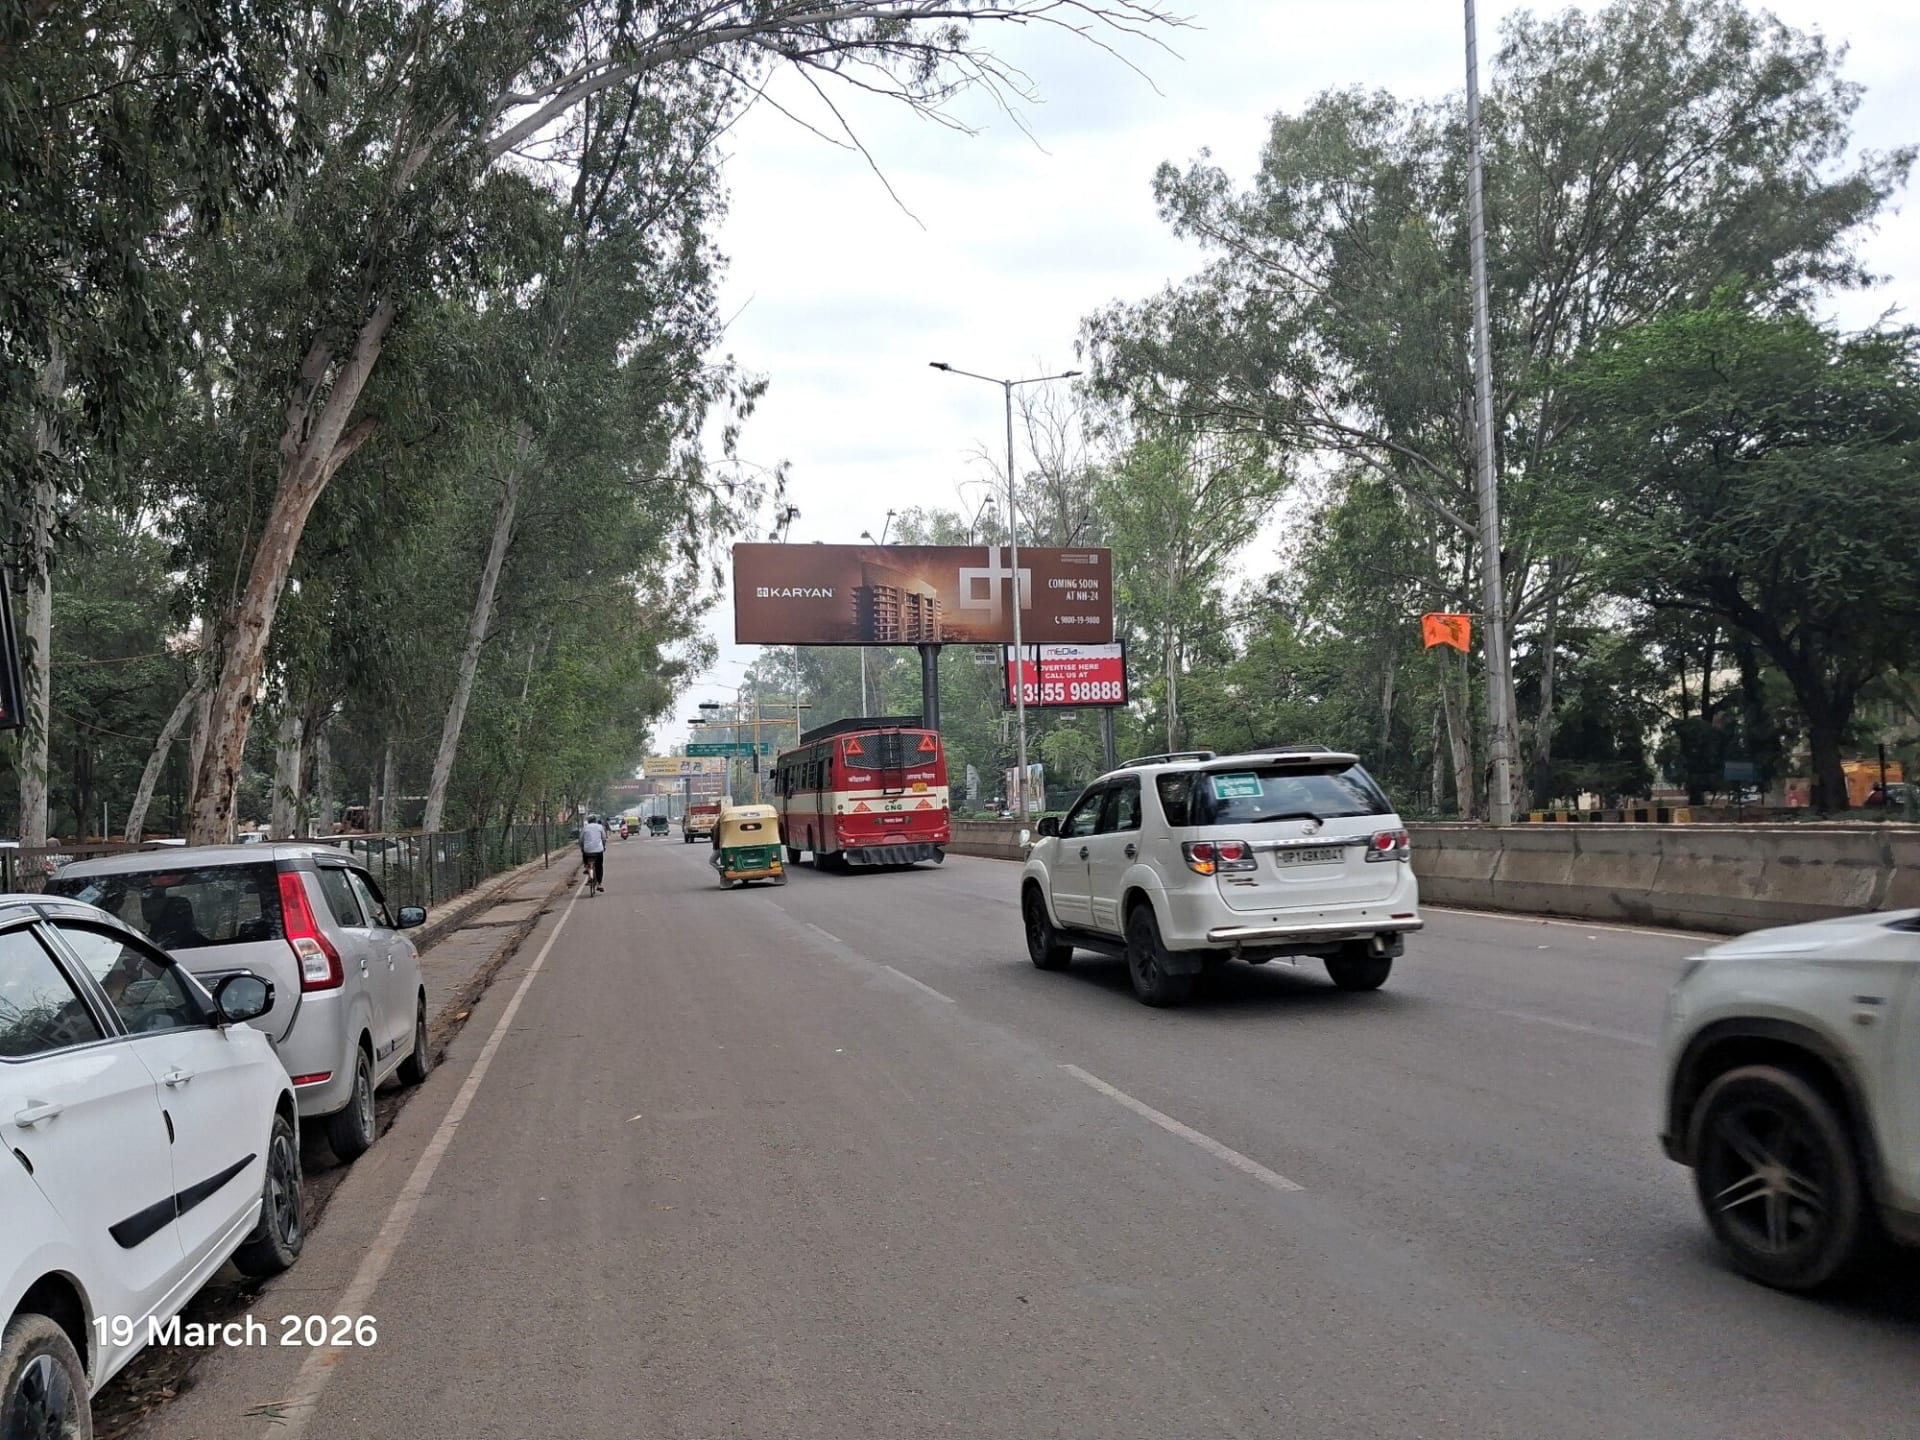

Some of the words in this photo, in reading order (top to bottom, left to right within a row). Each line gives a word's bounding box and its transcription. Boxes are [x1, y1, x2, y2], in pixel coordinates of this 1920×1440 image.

[1048, 578, 1077, 589] COMING
[1078, 578, 1099, 589] SOON
[770, 587, 833, 598] KARYAN
[1066, 591, 1075, 601] AT
[1076, 591, 1099, 601] NH-24
[1078, 663, 1099, 671] HERE
[1070, 681, 1121, 700] 98888
